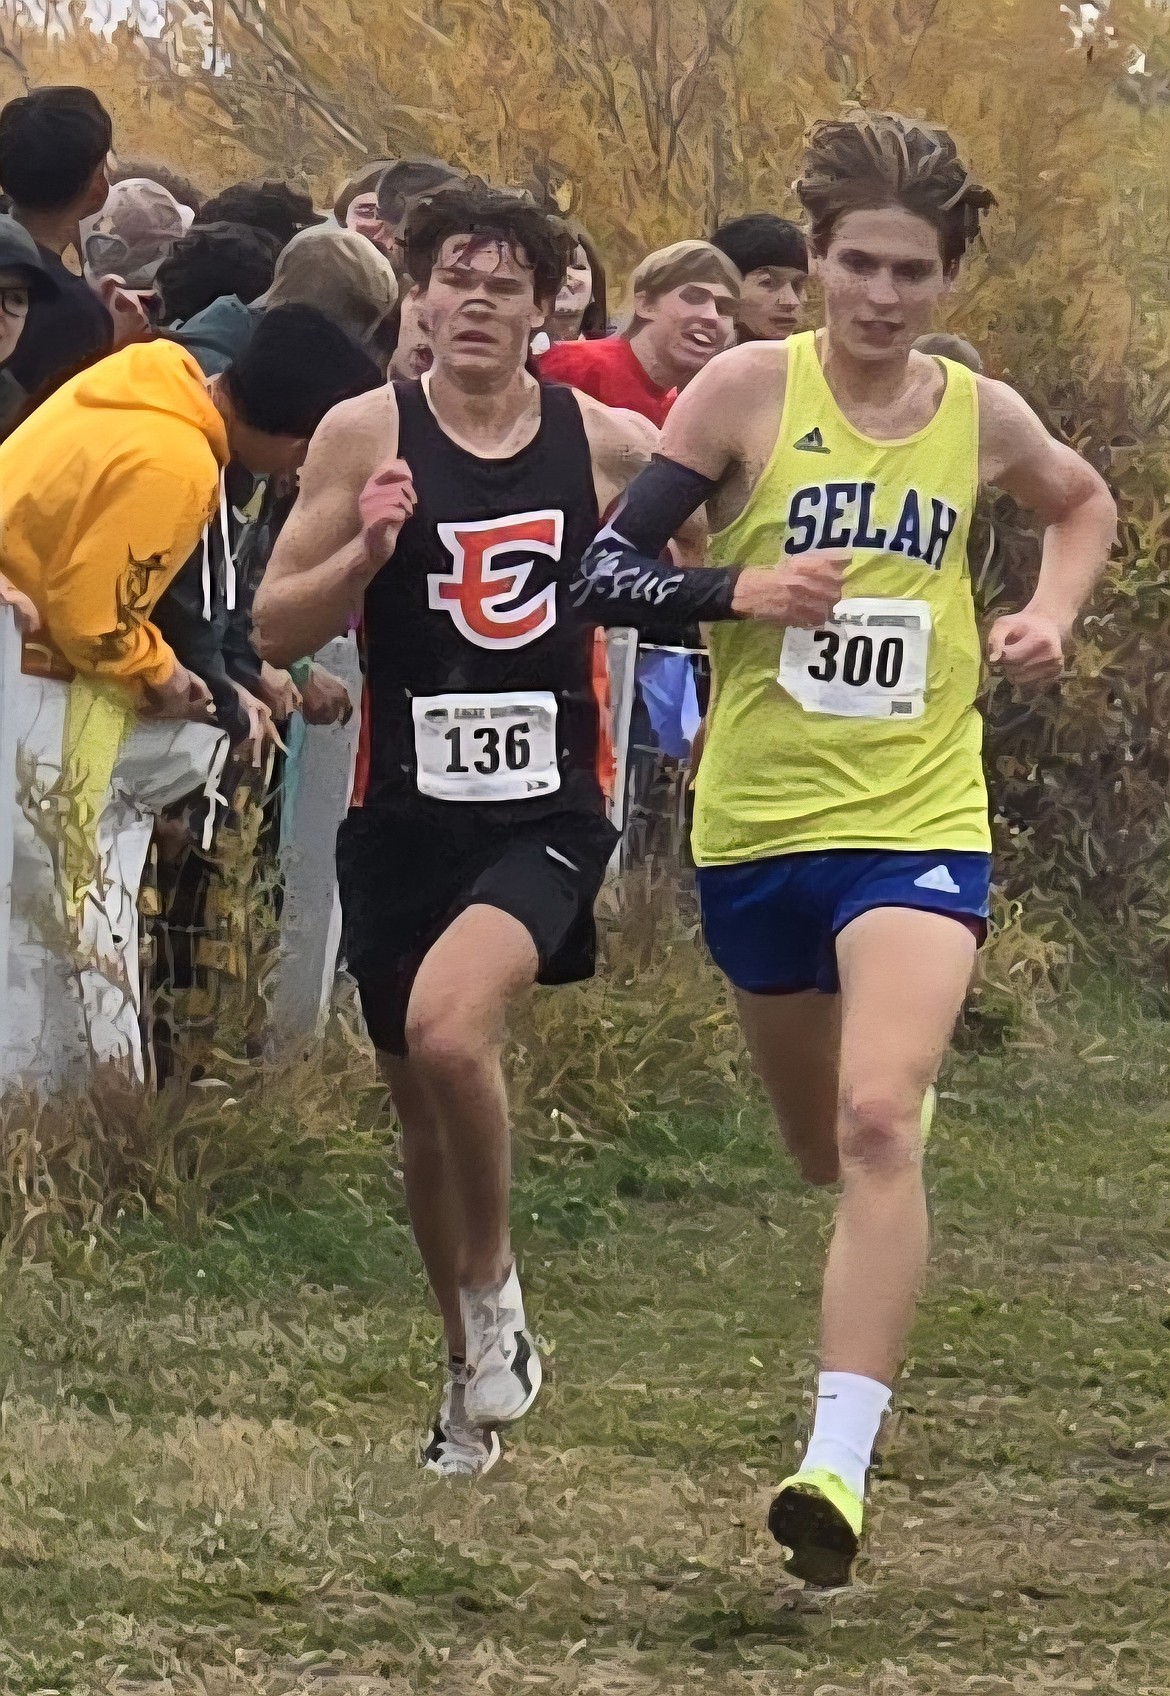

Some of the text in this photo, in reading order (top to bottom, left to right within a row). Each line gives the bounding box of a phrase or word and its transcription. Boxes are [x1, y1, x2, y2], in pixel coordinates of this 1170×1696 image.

[784, 482, 957, 570] SELAH
[807, 630, 904, 688] 300
[444, 721, 531, 775] 136
